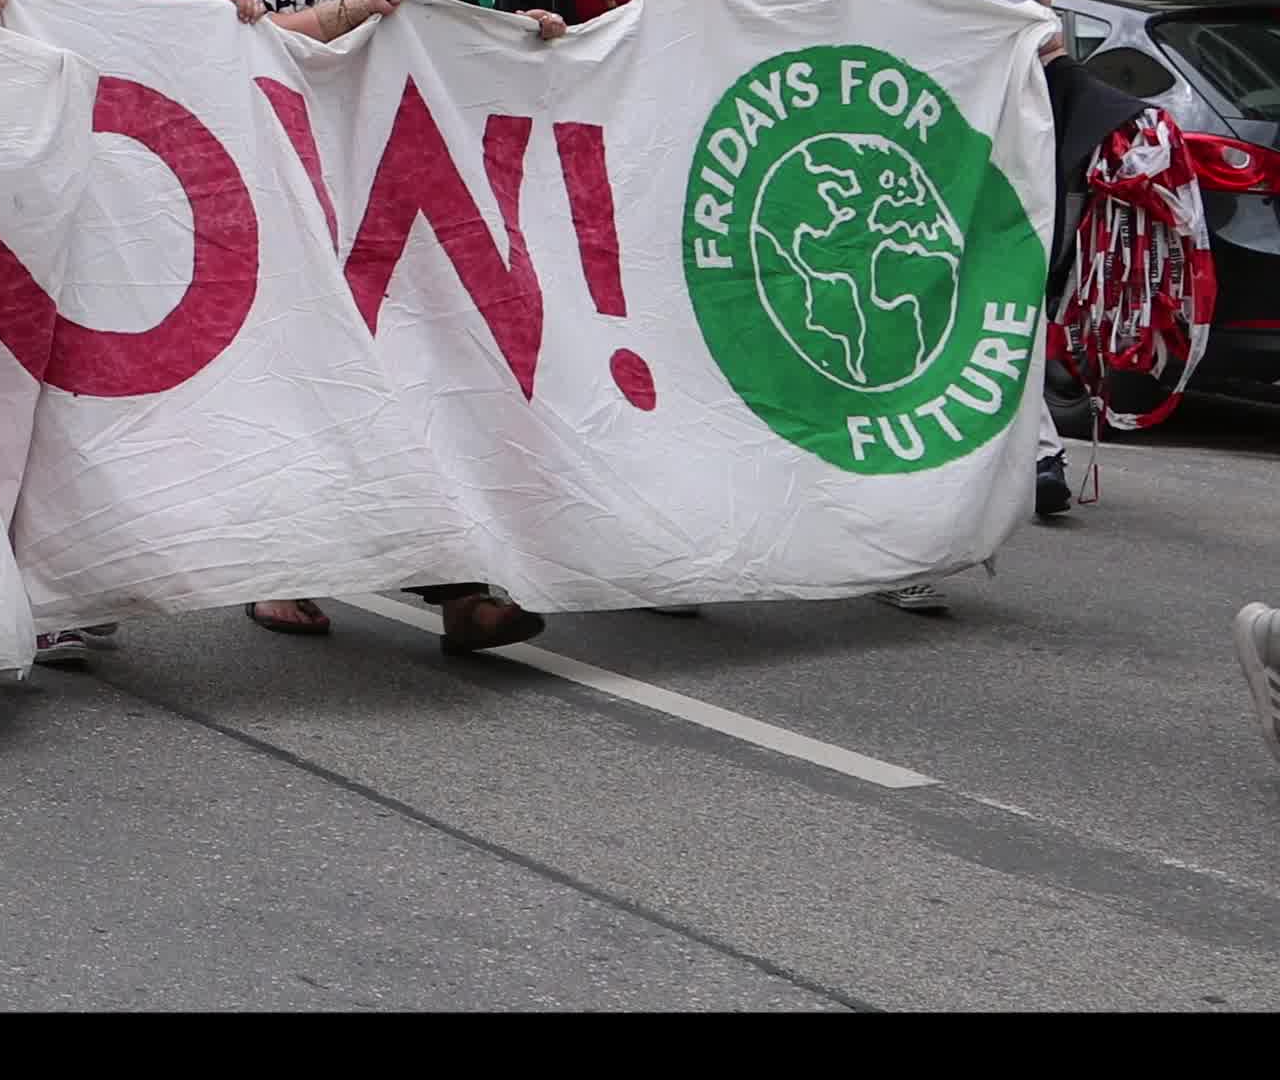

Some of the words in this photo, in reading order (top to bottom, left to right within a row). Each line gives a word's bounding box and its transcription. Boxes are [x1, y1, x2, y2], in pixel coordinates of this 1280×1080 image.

[693, 61, 820, 270] FRIDAYS
[839, 59, 942, 144] FOR
[846, 301, 1037, 462] FUTURE
